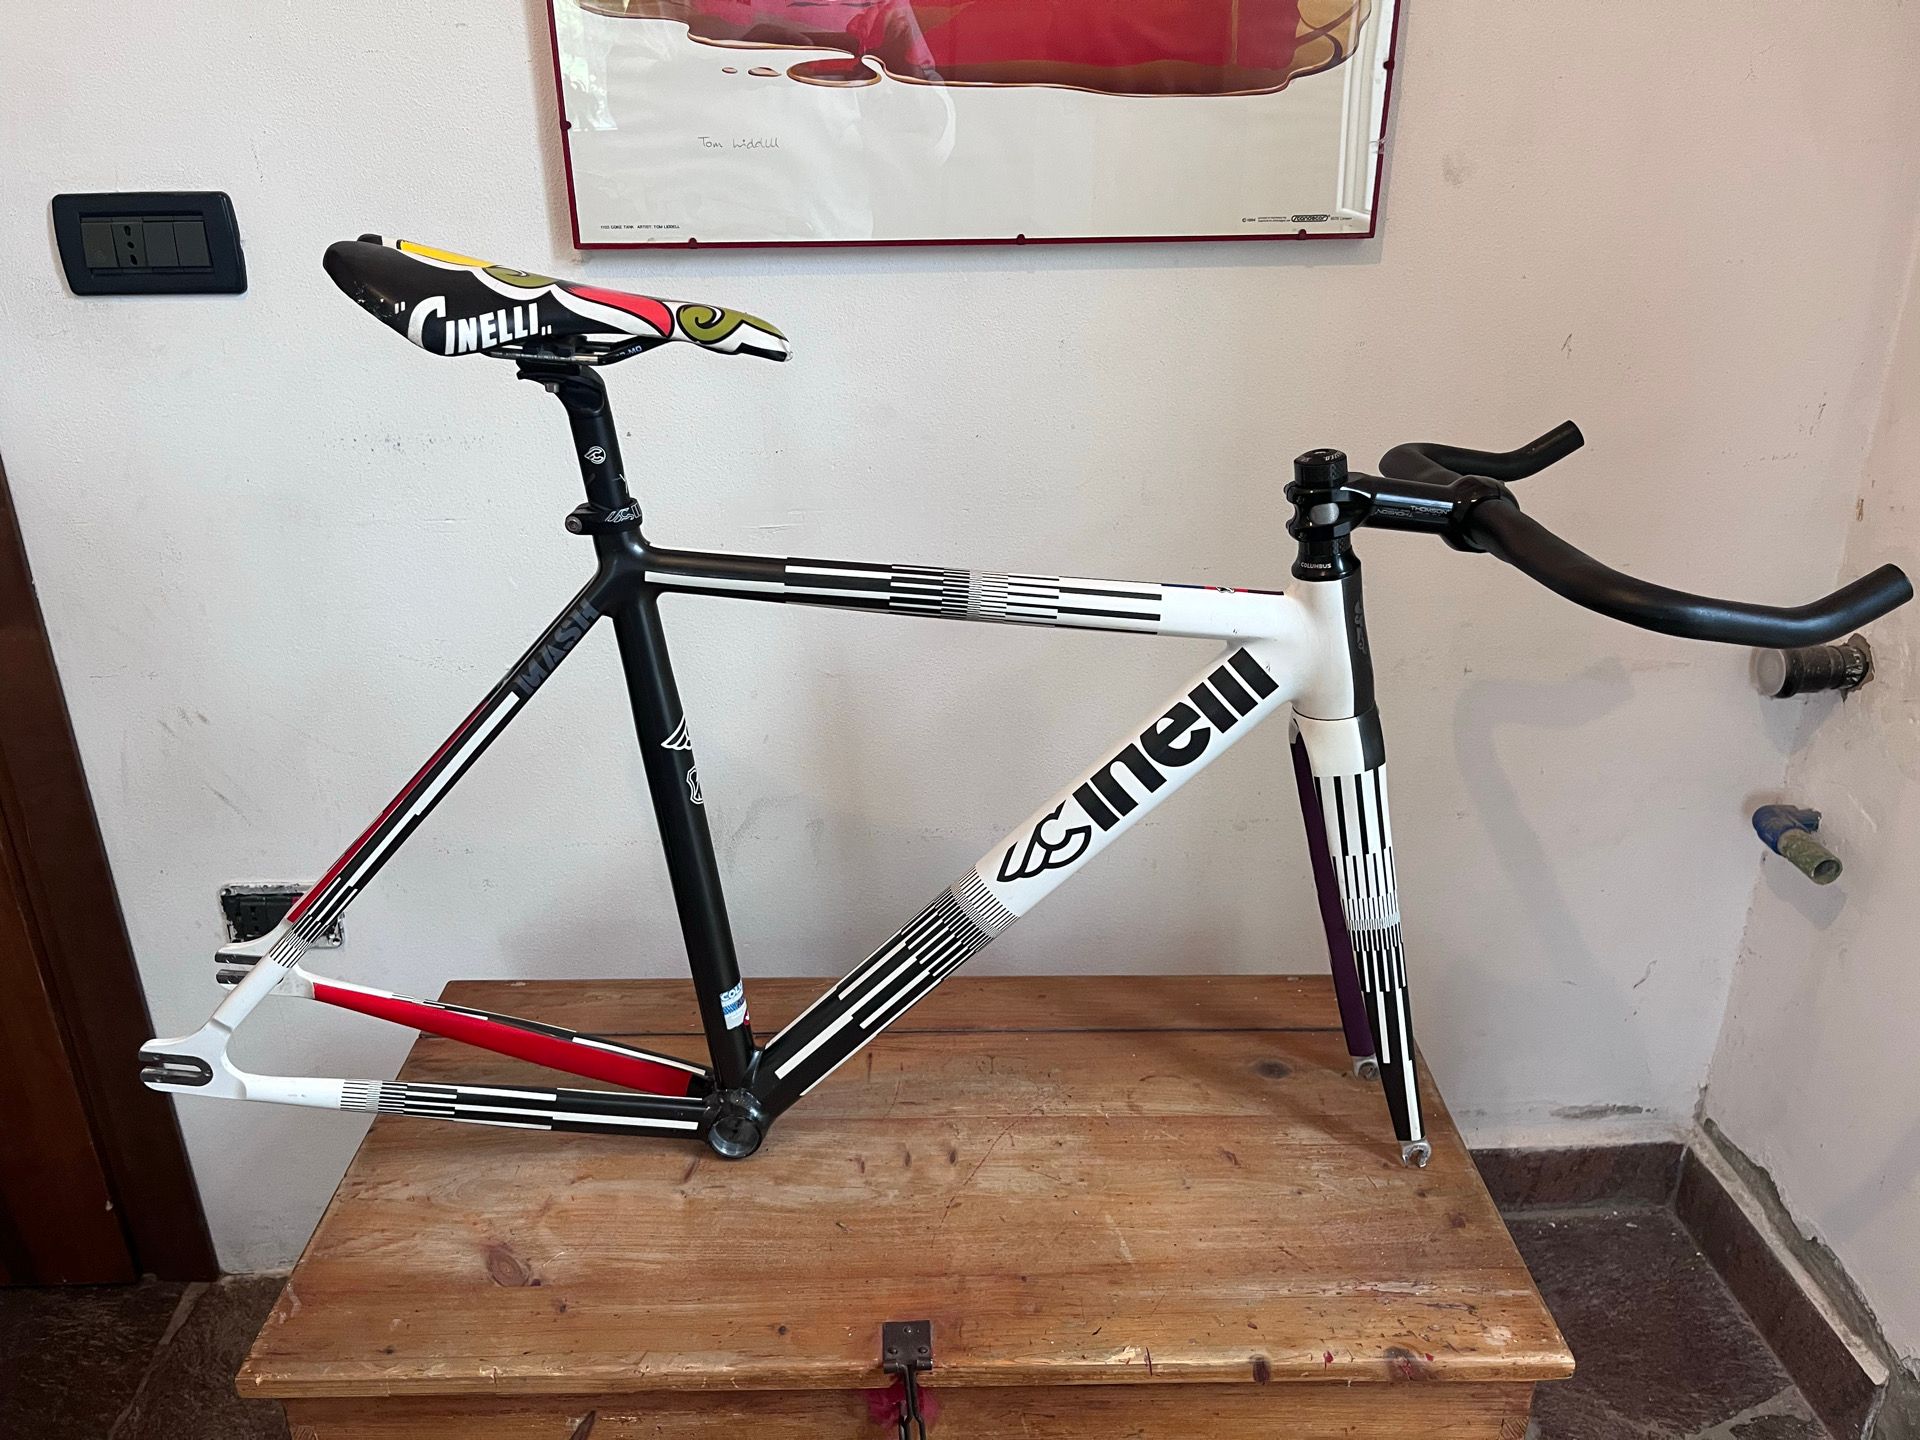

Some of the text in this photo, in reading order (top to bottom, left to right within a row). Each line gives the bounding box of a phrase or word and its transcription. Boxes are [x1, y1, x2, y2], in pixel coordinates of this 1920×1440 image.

[697, 136, 723, 148] Tom
[1300, 561, 1332, 569] COLUMBUS
[513, 597, 600, 696] MASH
